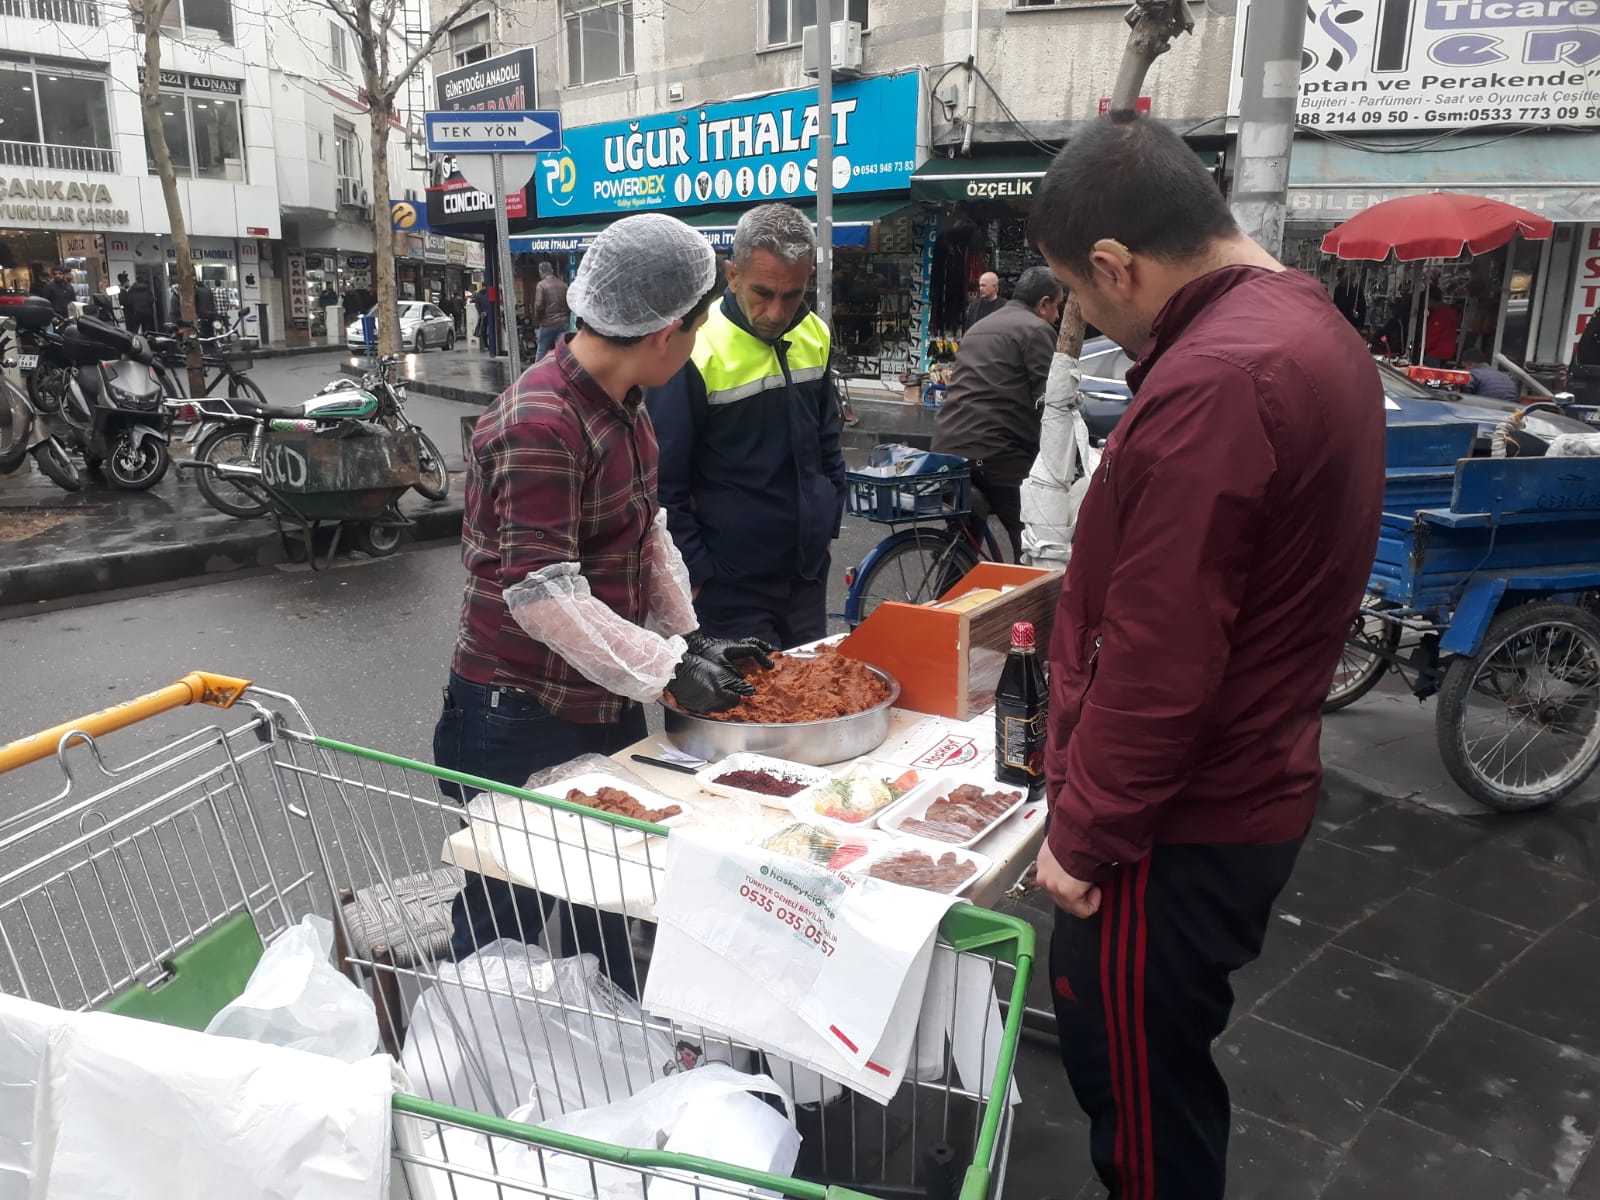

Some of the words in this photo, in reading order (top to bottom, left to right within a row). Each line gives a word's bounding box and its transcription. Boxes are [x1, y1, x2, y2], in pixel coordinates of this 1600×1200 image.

[193, 77, 237, 92] ADNAN
[445, 72, 485, 98] GÜNEYDOĞU
[486, 62, 520, 87] ANADOLU
[1299, 80, 1367, 96] ptan
[1378, 79, 1411, 91] ve
[1301, 96, 1347, 109] Bujiteri
[1358, 95, 1423, 107] Parfümeri
[1434, 94, 1463, 104] Saat
[1468, 94, 1483, 103] ve
[1487, 91, 1548, 105] Oyuncak
[1325, 112, 1356, 123] 214
[1361, 111, 1382, 123] 09
[1387, 111, 1408, 122] 50
[1424, 108, 1512, 122] Gsm:0533
[1518, 107, 1550, 119] 773
[1556, 107, 1579, 119] 09
[441, 126, 472, 138] TEK
[483, 123, 518, 137] YÖN
[604, 121, 692, 174] UĞUR
[698, 97, 858, 163] İTHALAT
[860, 163, 878, 175] 0543
[894, 161, 903, 172] 73
[593, 174, 666, 200] POWERDEX
[966, 178, 1033, 199] ÖZÇELİK
[77, 207, 130, 227] ÇARŞISI
[531, 239, 550, 250] UĞUR
[550, 239, 578, 250] İTHALAT
[703, 231, 720, 245] ĞUR
[739, 884, 775, 913] 0535
[776, 907, 804, 931] 035
